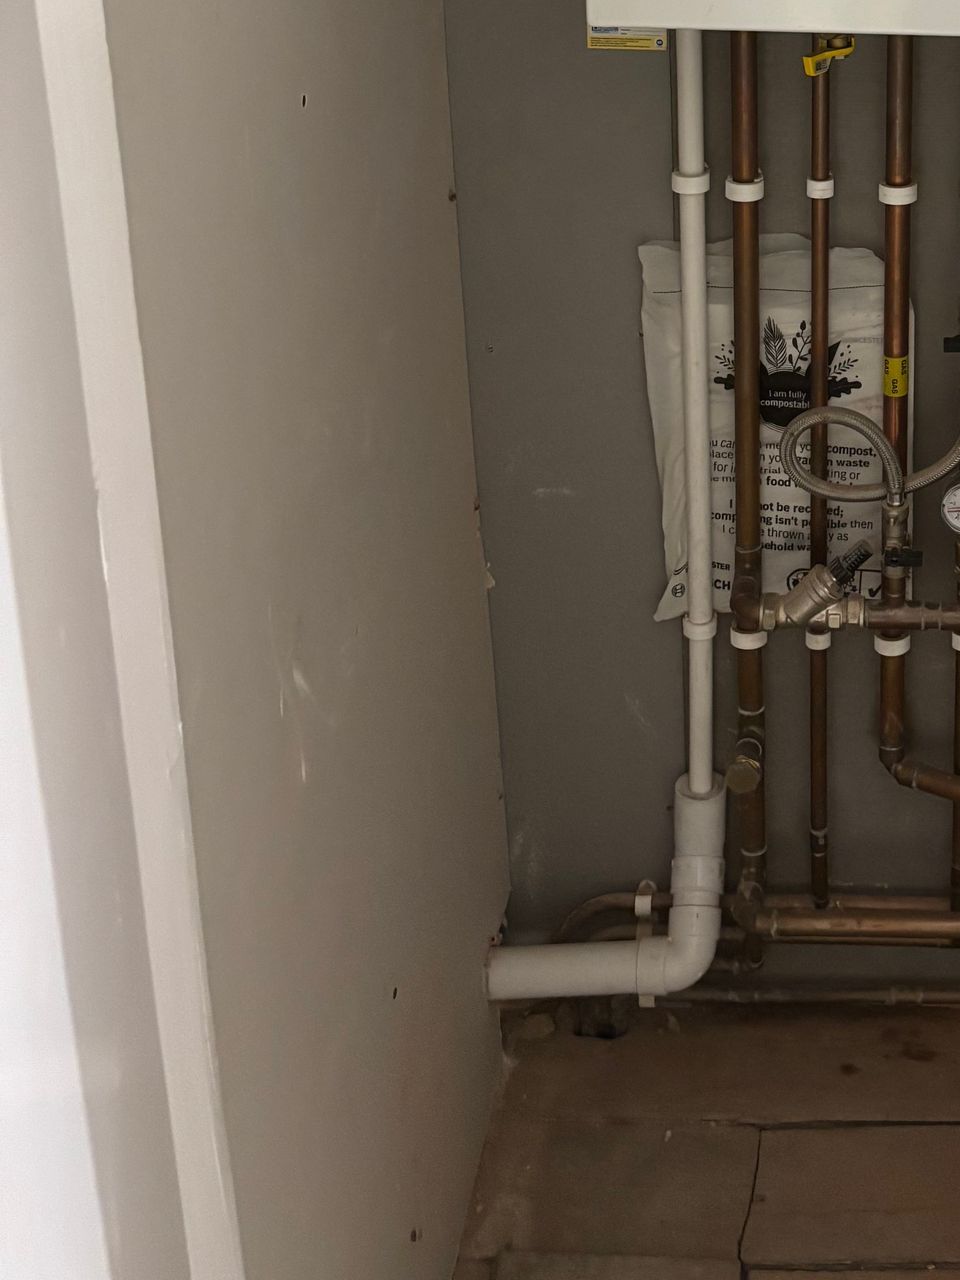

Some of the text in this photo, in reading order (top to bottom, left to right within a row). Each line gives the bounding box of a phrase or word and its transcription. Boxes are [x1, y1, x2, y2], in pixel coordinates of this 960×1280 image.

[891, 378, 899, 394] GAS
[760, 399, 810, 409] compostabl
[711, 450, 734, 460] lace
[836, 458, 871, 468] waste
[713, 461, 729, 473] for
[849, 472, 861, 481] or
[766, 475, 792, 488] food
[776, 502, 790, 513] be
[775, 515, 874, 530] isn't then
[767, 527, 805, 540] thrown
[836, 532, 849, 541] as
